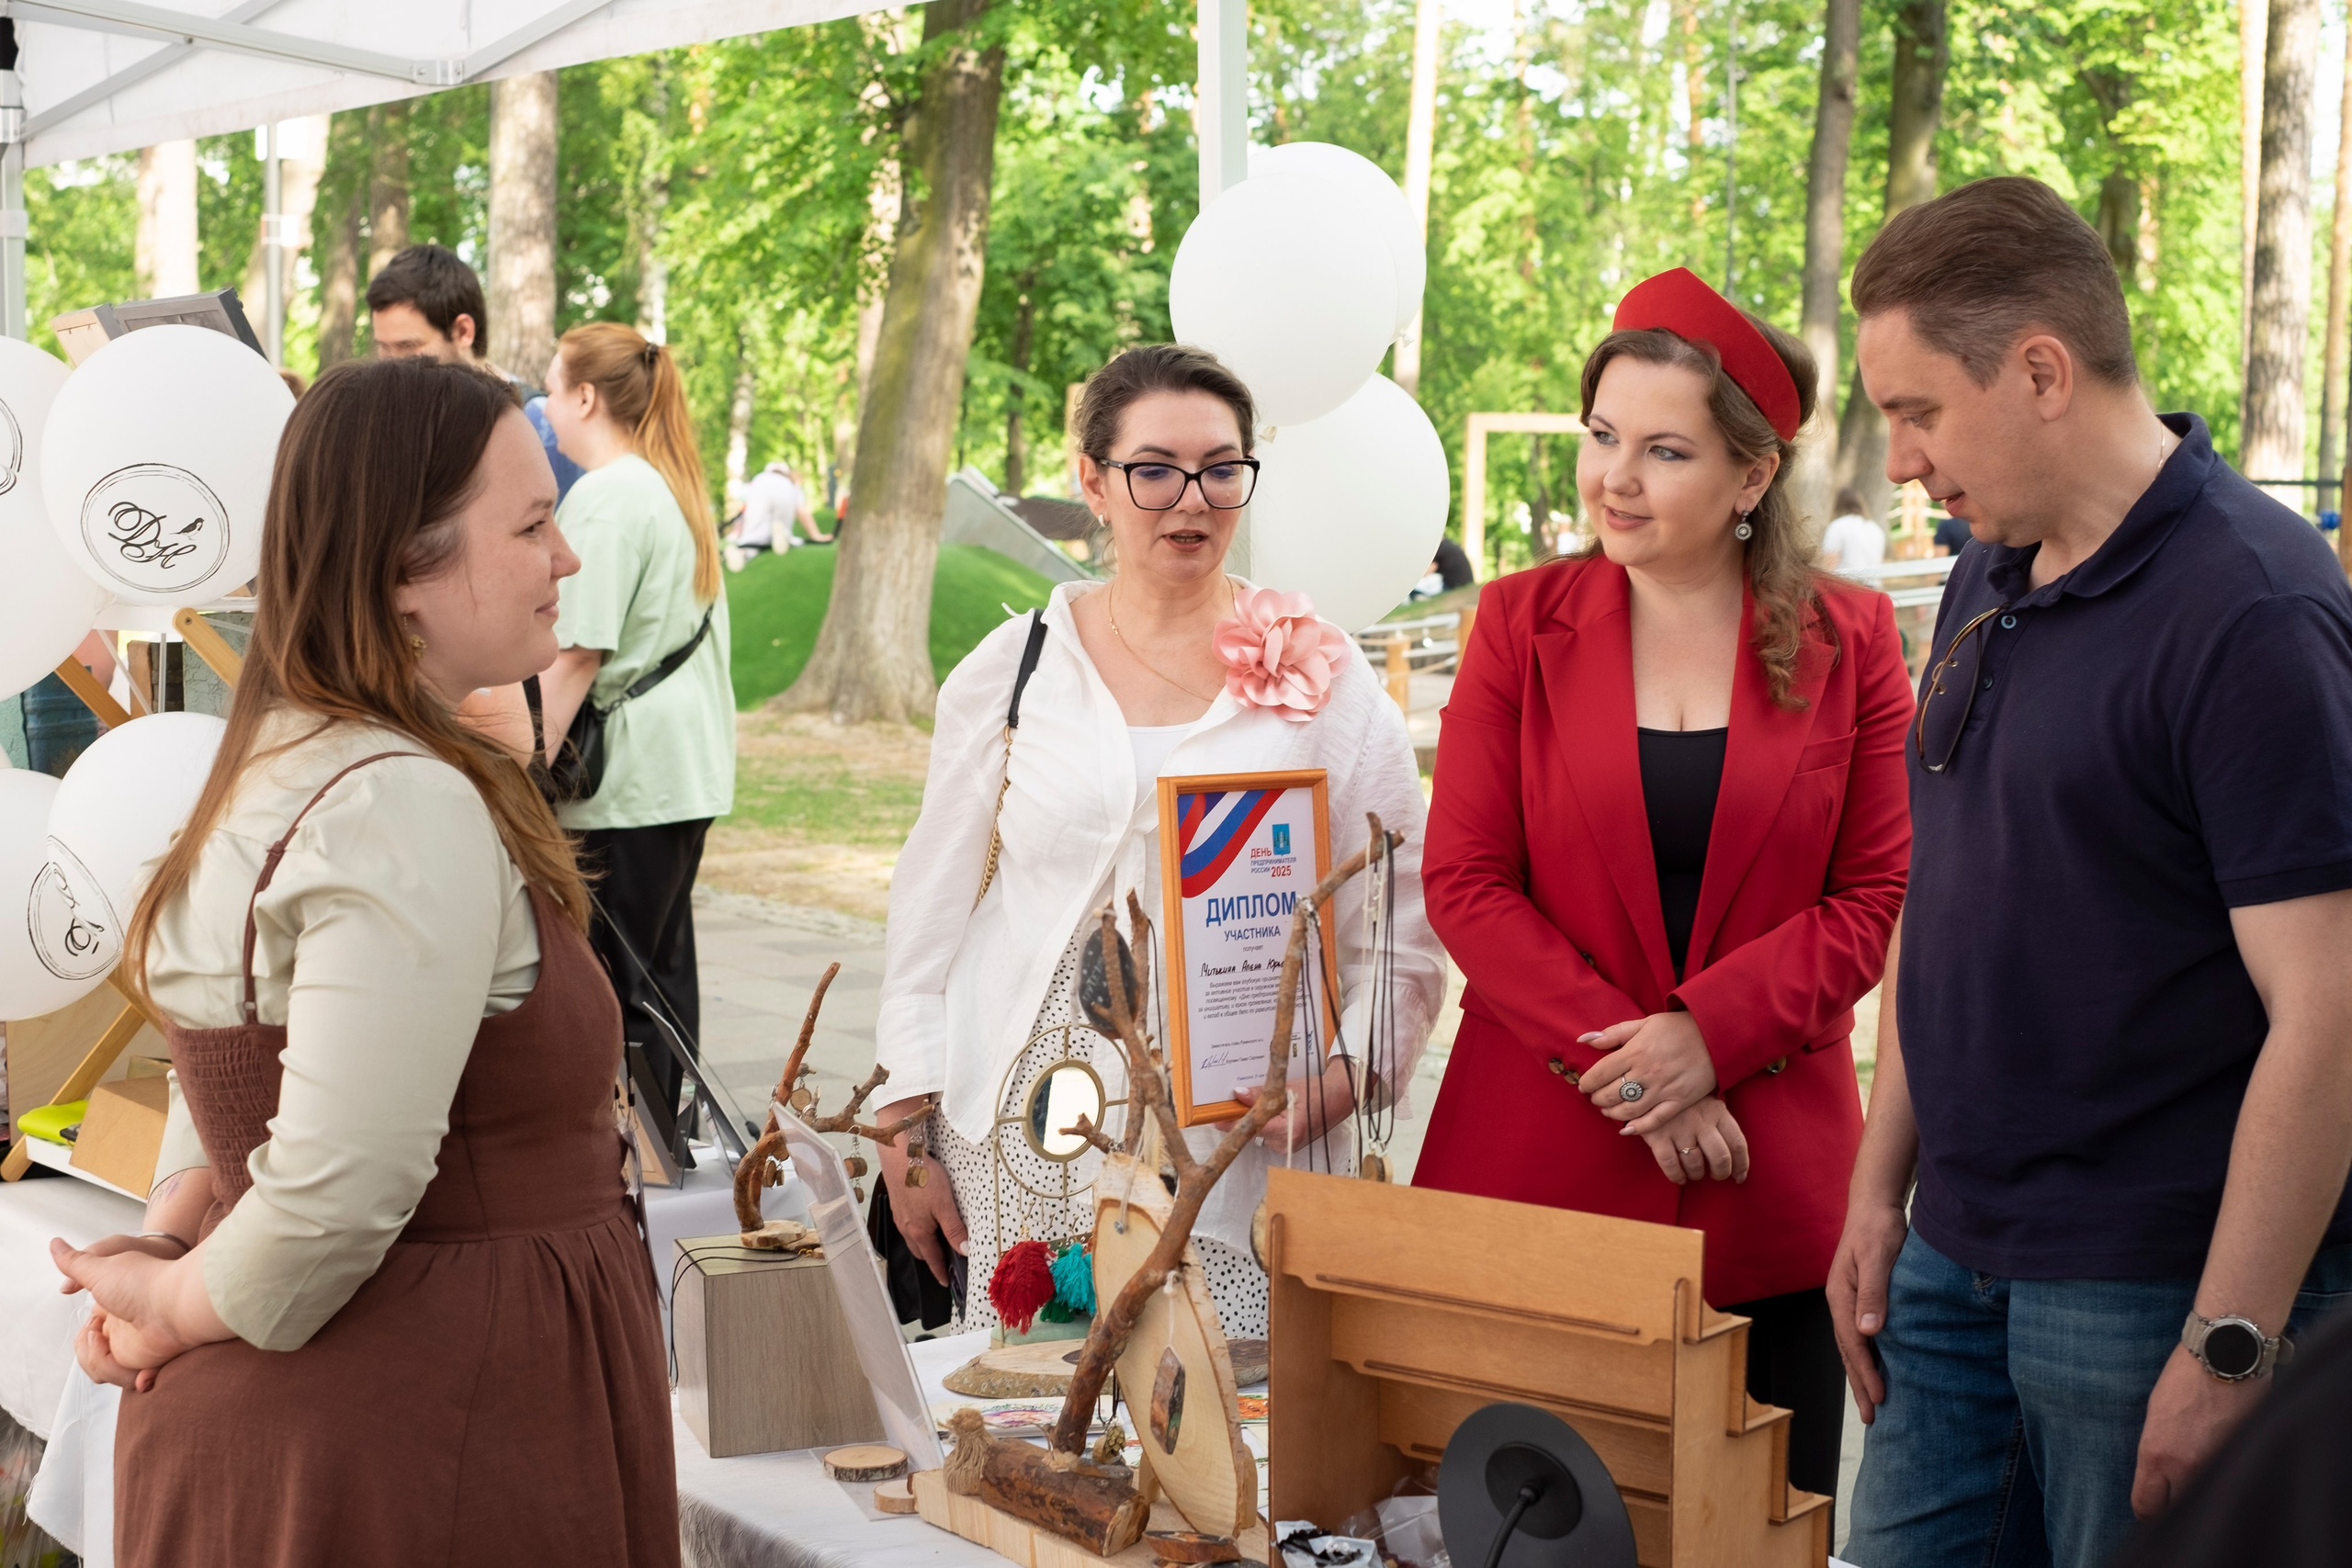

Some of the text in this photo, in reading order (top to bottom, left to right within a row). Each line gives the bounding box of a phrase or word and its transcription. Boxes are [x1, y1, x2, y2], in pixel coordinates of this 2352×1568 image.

[1251, 849, 1272, 859] ДЕНЬ
[1272, 865, 1291, 877] 2025
[1206, 891, 1295, 928] ДИПЛОМ
[1224, 925, 1281, 942] УЧАСТНИКА
